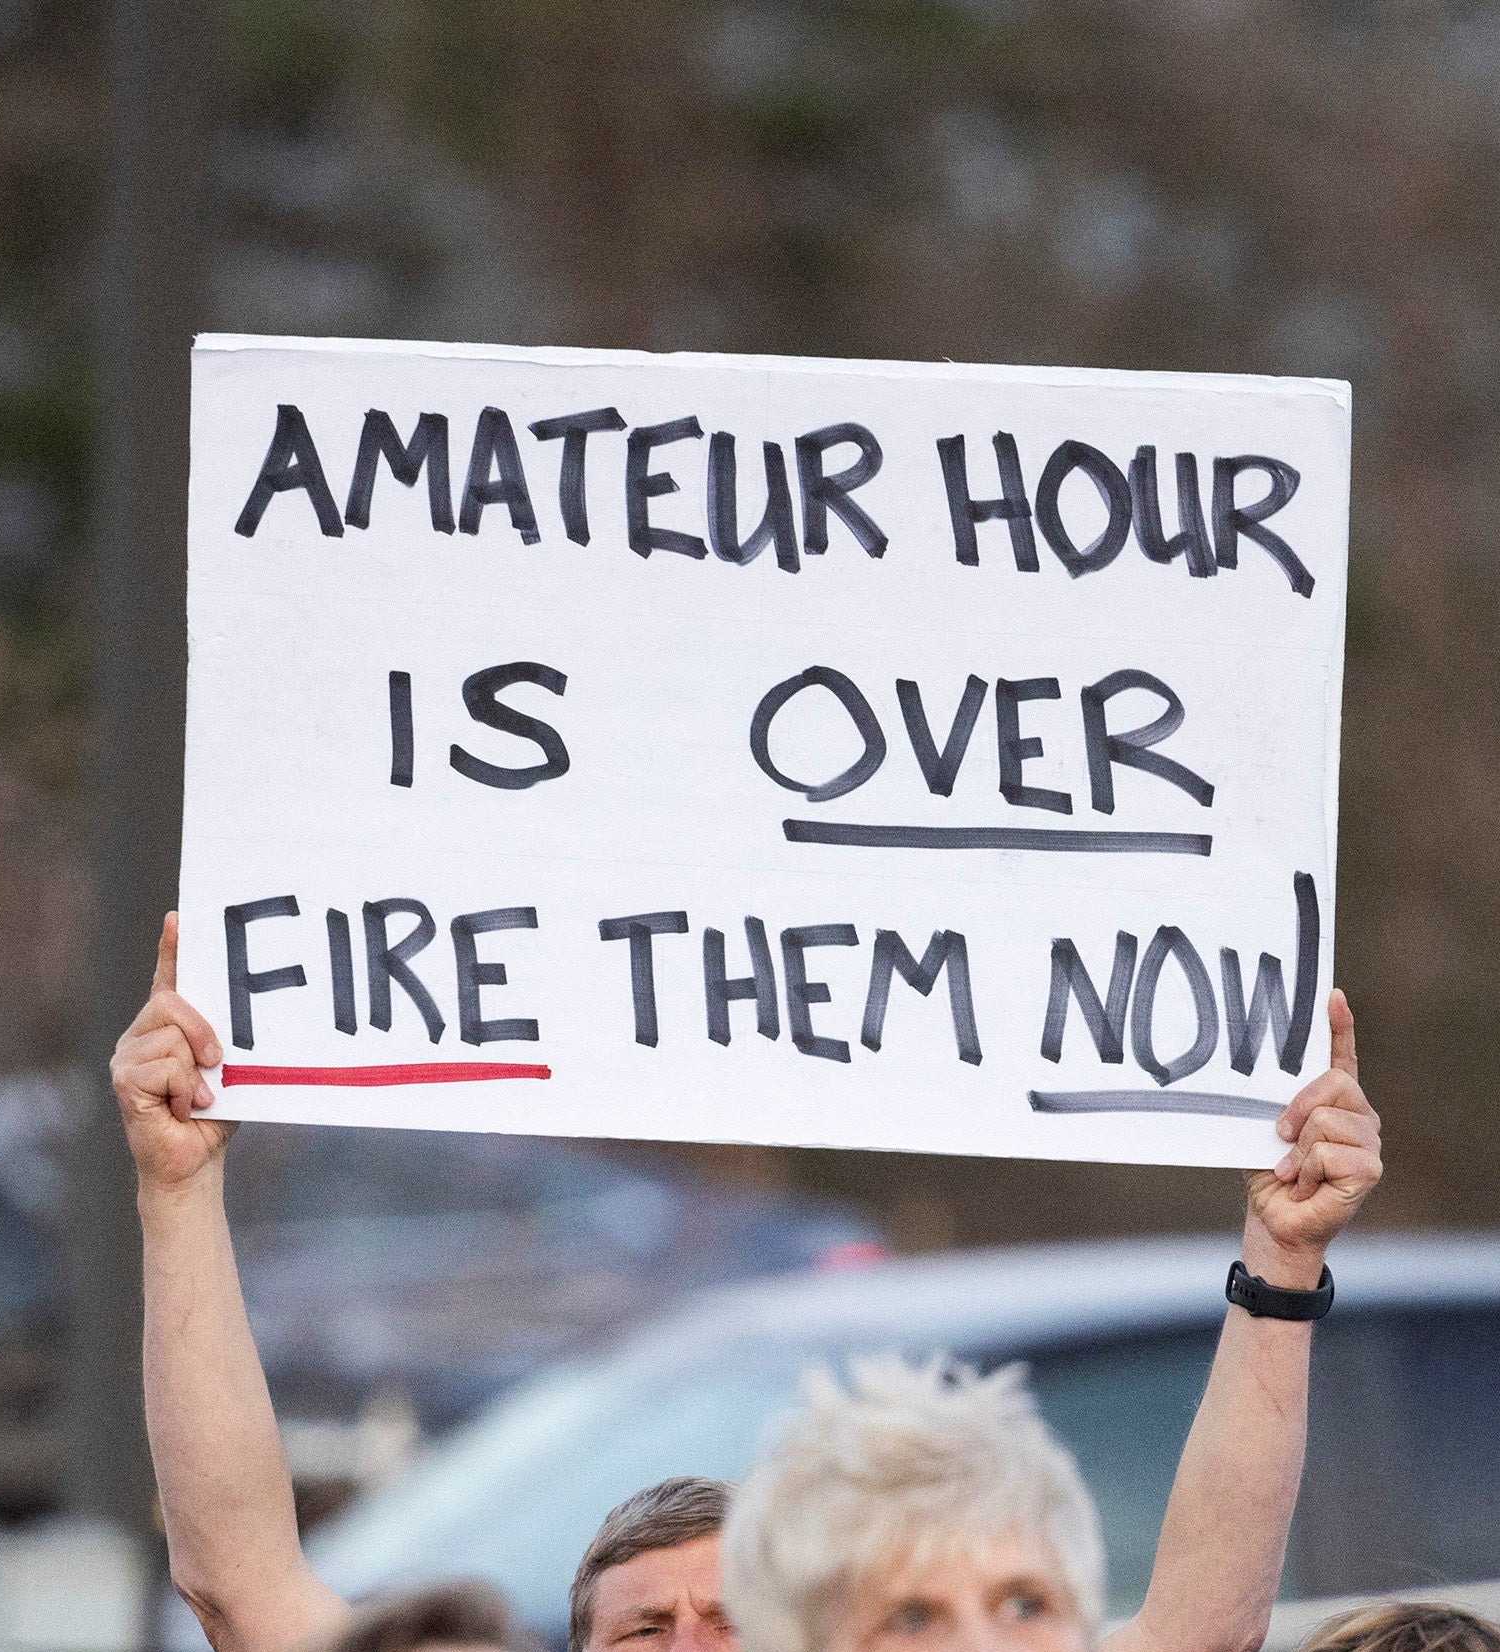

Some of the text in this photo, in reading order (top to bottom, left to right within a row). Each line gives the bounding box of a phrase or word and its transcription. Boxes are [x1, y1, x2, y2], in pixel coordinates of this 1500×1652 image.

[235, 404, 1315, 598] AMATEUR HOUR
[389, 662, 1214, 814] IS OVER
[224, 871, 1320, 1086] FIRE THEM NOW
